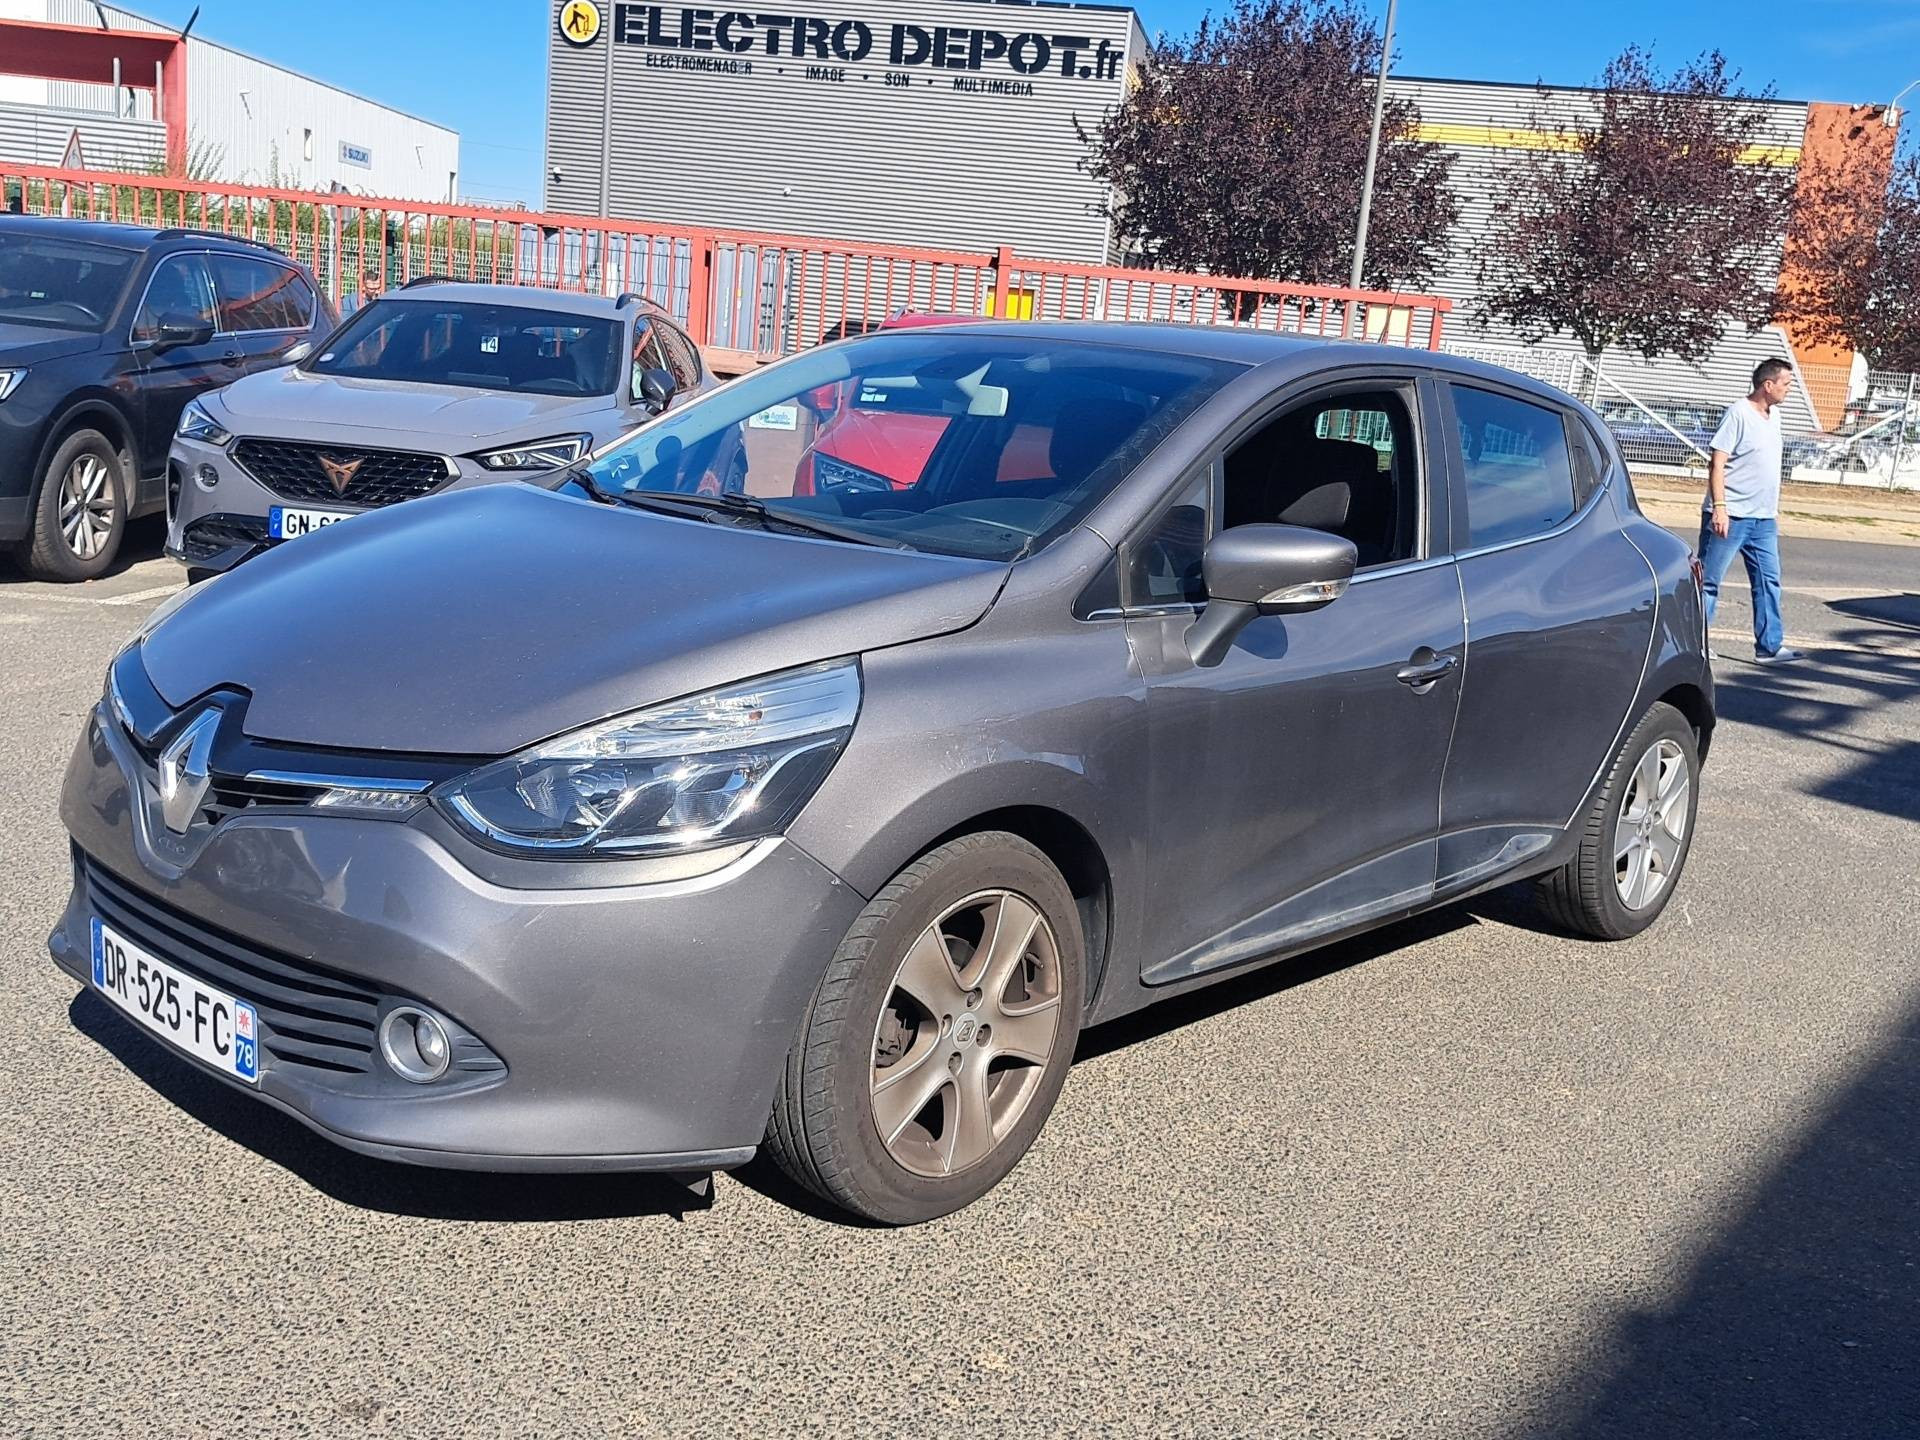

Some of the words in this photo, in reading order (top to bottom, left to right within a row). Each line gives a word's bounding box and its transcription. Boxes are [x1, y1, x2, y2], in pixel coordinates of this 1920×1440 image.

[615, 3, 873, 62] ELECTRO
[889, 23, 1125, 80] DEPOT.fr
[805, 66, 846, 83] IMAGE
[884, 72, 910, 88] SON
[953, 78, 1033, 97] MULTIMEDIA
[347, 147, 369, 164] SUZUKI
[482, 336, 497, 352] 14
[286, 513, 341, 535] GN-6
[96, 958, 102, 972] F
[104, 937, 229, 1056] DR-525-FC
[236, 1039, 254, 1069] 78
